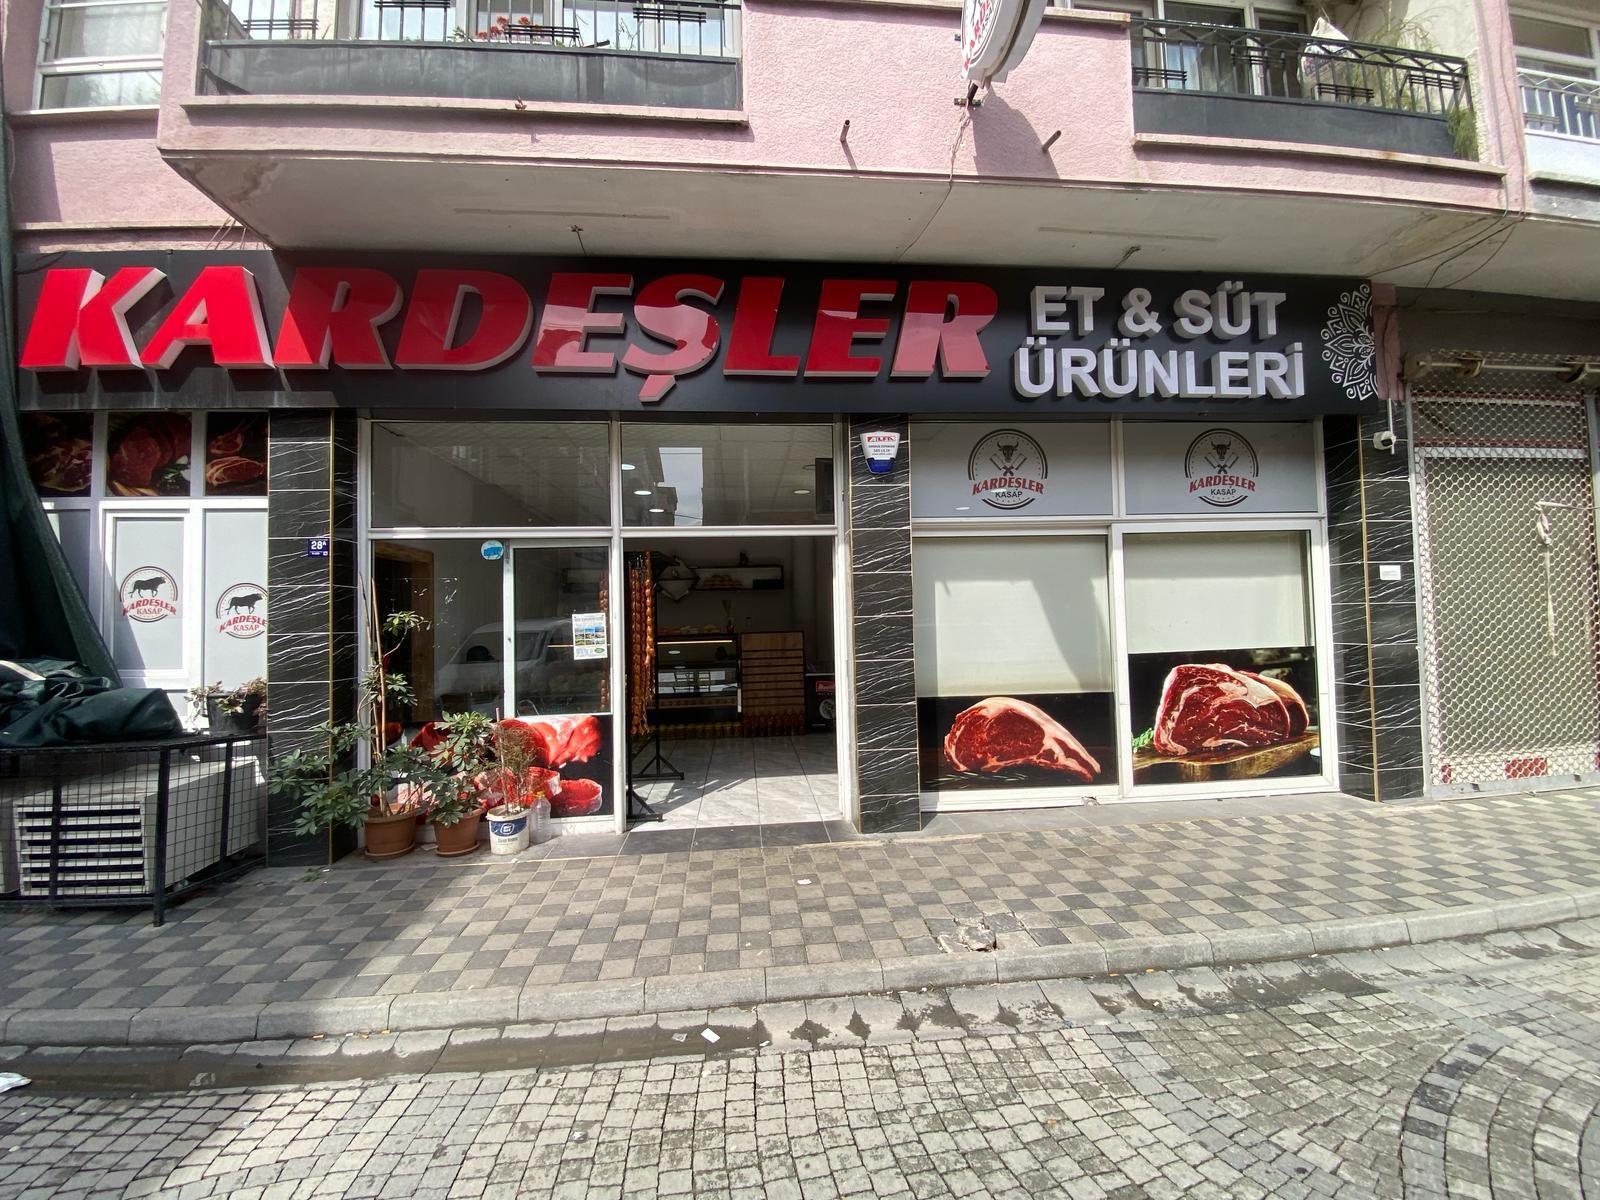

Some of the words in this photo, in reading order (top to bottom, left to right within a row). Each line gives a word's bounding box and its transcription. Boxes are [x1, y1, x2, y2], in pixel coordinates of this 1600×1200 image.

[1030, 286, 1104, 336] ET
[1117, 288, 1162, 338] &
[1173, 281, 1286, 339] SÜT
[19, 266, 998, 402] KARDEŞLER
[1014, 337, 1305, 399] ÜRÜNLERİ
[972, 477, 1044, 496] KARDEŞLER
[1189, 475, 1256, 493] KARDEŞLER
[1210, 488, 1236, 496] KASAP
[995, 490, 1023, 498] KASAP
[122, 598, 177, 616] KARDEŞLER
[218, 615, 267, 633] KARDEŞLE
[233, 624, 260, 632] KASAP
